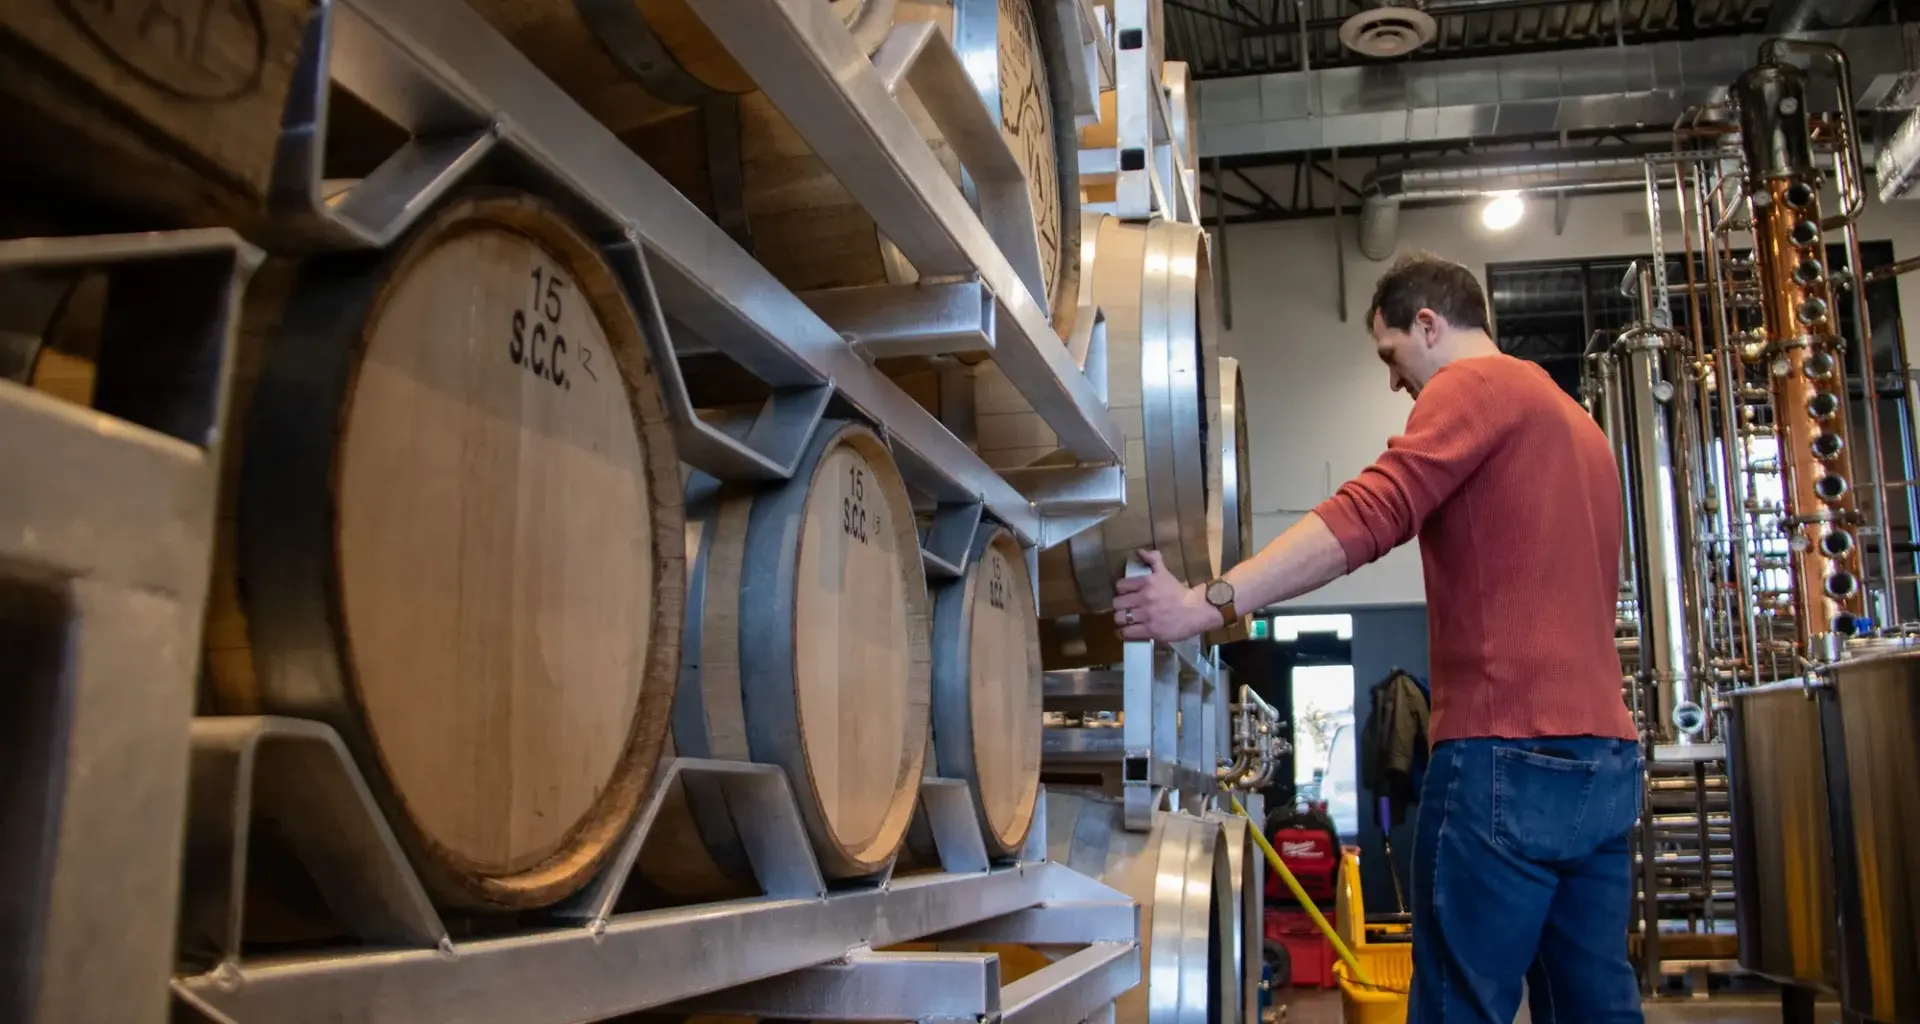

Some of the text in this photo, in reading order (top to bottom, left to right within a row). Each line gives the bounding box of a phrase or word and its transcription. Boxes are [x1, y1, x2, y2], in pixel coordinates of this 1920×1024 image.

[531, 265, 564, 324] 15
[510, 308, 571, 391] S.C.C.
[849, 465, 863, 501] 15
[843, 497, 868, 546] S.C.C.
